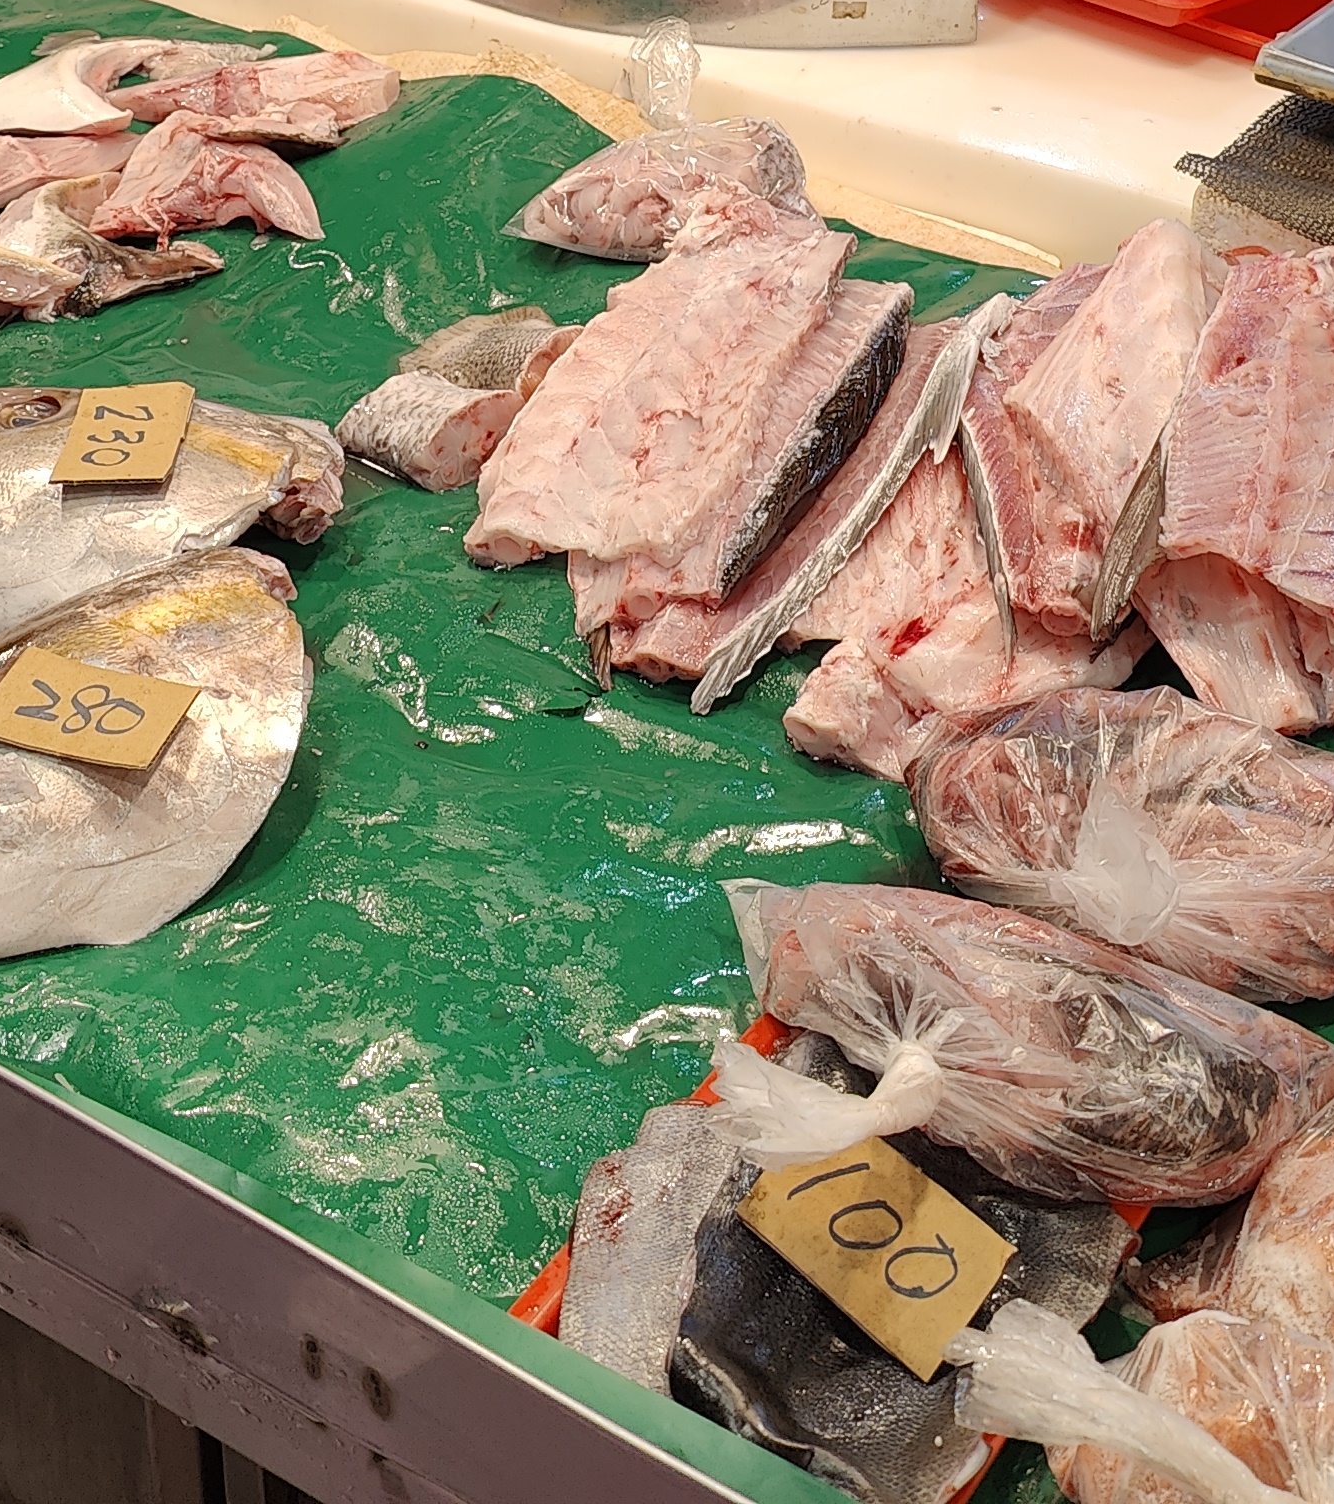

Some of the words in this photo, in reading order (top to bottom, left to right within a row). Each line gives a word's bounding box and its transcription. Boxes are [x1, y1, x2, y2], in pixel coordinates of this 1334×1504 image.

[81, 403, 156, 468] 230
[15, 678, 145, 736] 280
[788, 1163, 957, 1299] 100
